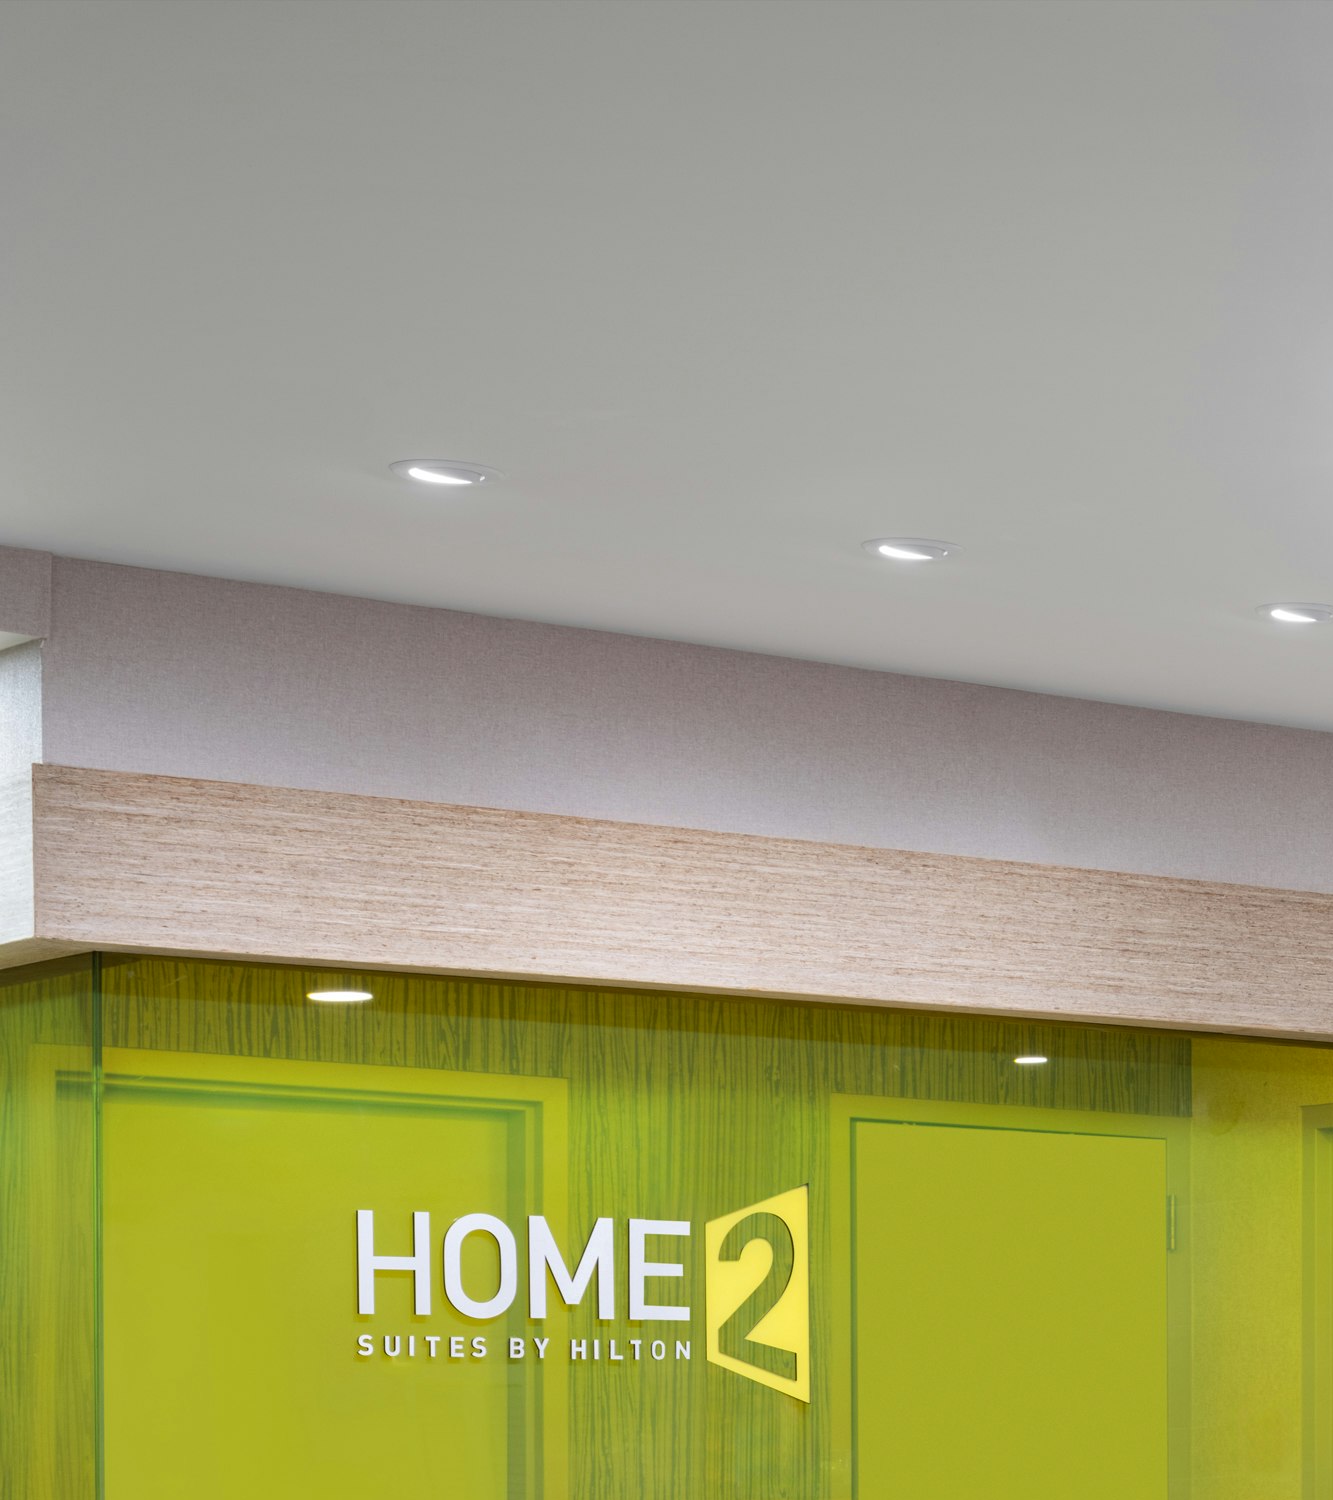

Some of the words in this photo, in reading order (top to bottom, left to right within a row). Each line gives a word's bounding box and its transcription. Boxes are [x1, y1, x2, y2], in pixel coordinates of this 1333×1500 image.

[356, 1209, 691, 1321] HOME
[714, 1207, 801, 1387] 2
[357, 1334, 488, 1358] SUITES
[509, 1337, 550, 1359] BY
[570, 1339, 691, 1361] HILTON
